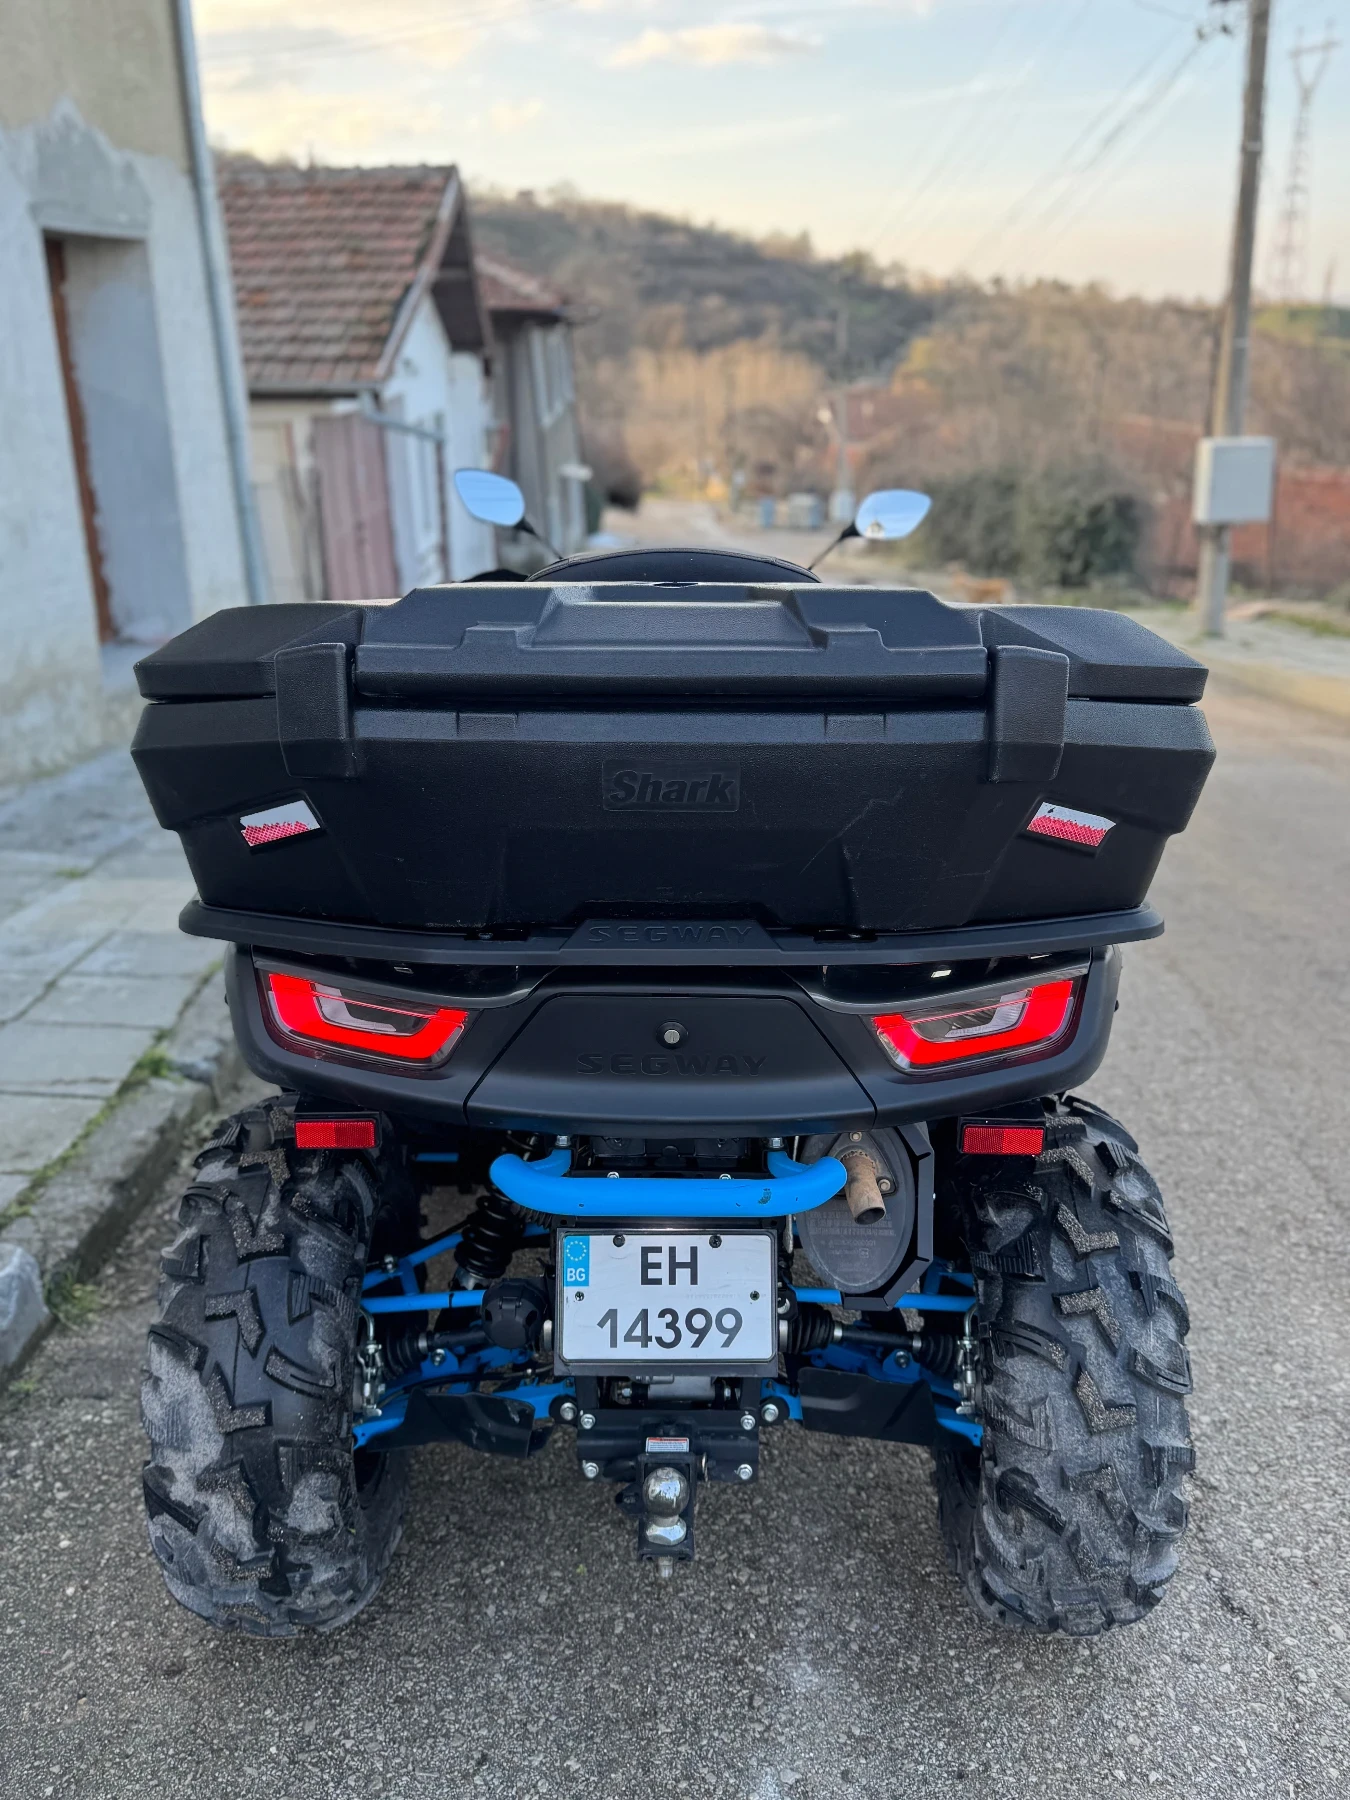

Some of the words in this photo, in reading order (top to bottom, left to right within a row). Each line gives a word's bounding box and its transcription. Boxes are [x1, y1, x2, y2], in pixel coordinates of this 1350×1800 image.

[609, 769, 735, 803] Shark
[588, 926, 752, 944] SEGWAY
[576, 1053, 768, 1077] SEGWAY
[566, 1267, 586, 1282] BG
[640, 1246, 699, 1286] EH
[597, 1307, 743, 1349] 14399
